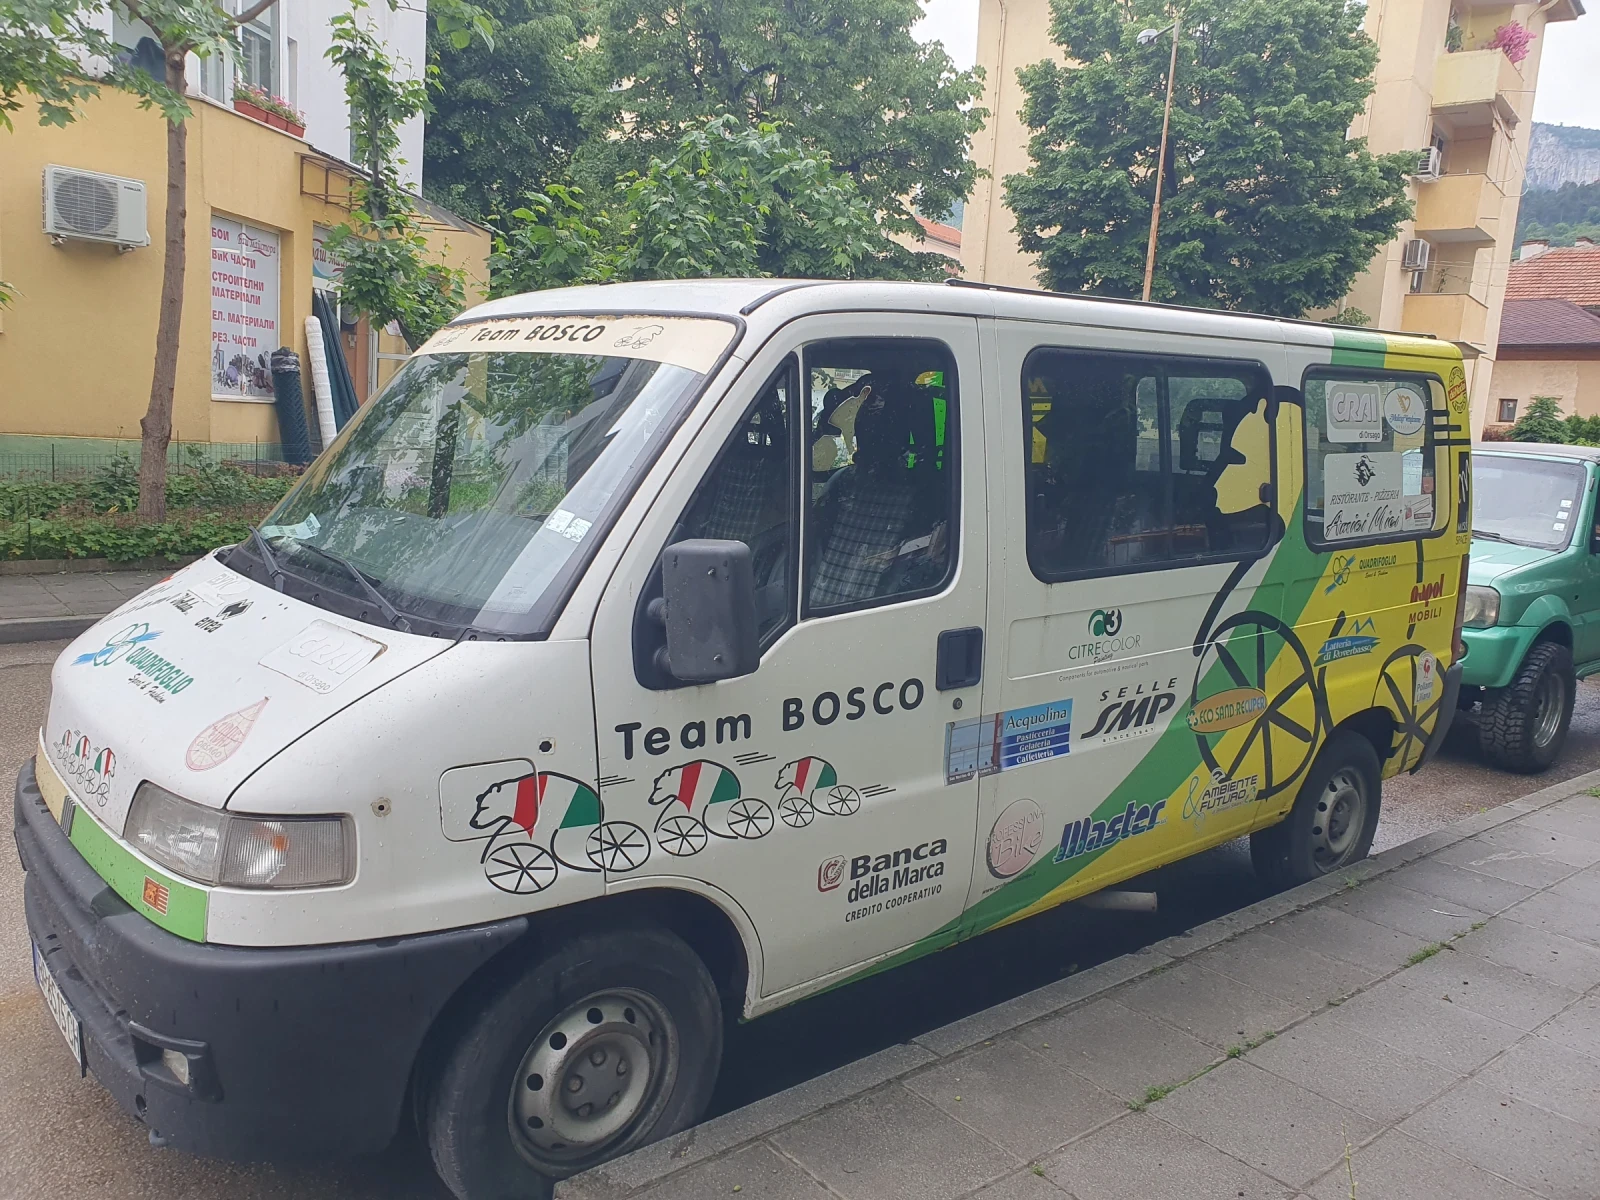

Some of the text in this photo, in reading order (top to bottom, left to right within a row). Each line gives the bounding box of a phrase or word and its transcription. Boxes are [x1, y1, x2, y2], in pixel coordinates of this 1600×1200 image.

[211, 226, 229, 241] БОИ
[230, 253, 256, 269] ЧАСТИ
[211, 271, 264, 291] СТРОИТЕЛНИ
[212, 286, 261, 306] МАТЕРИАЛИ
[212, 309, 275, 330] ЕЛ. МАТЕРИАЛИ
[212, 331, 257, 348] РЕЗ. ЧАСТИ
[470, 324, 606, 343] Team BOSCO
[1333, 392, 1377, 422] CRAI
[1330, 492, 1370, 506] RISTORANTE
[1359, 554, 1397, 570] QUADRIFOGLIO
[1408, 606, 1442, 623] MOBILI
[1068, 634, 1141, 660] CITRECOLOR
[1325, 639, 1352, 652] Latteria
[1323, 651, 1331, 661] di
[125, 646, 194, 694] QUADRIFOGLIO
[305, 674, 331, 692] Orsago
[1099, 677, 1178, 702] SELLE
[614, 678, 924, 761] Team BOSCO
[1006, 706, 1067, 731] Acquolina
[1080, 692, 1176, 740] SMP
[1200, 708, 1214, 725] ECO
[1016, 727, 1056, 743] Pasticceria
[1103, 733, 1129, 743] SINCE
[1019, 739, 1051, 752] Gelateria
[1016, 749, 1054, 764] Caffetteria
[1202, 775, 1258, 800] AMBIENTE
[1200, 789, 1247, 813] FUTURO
[1054, 799, 1168, 864] Master
[850, 838, 948, 881] Banca
[847, 861, 945, 904] della Marca
[845, 884, 942, 923] CREDITO COOPERATIVO
